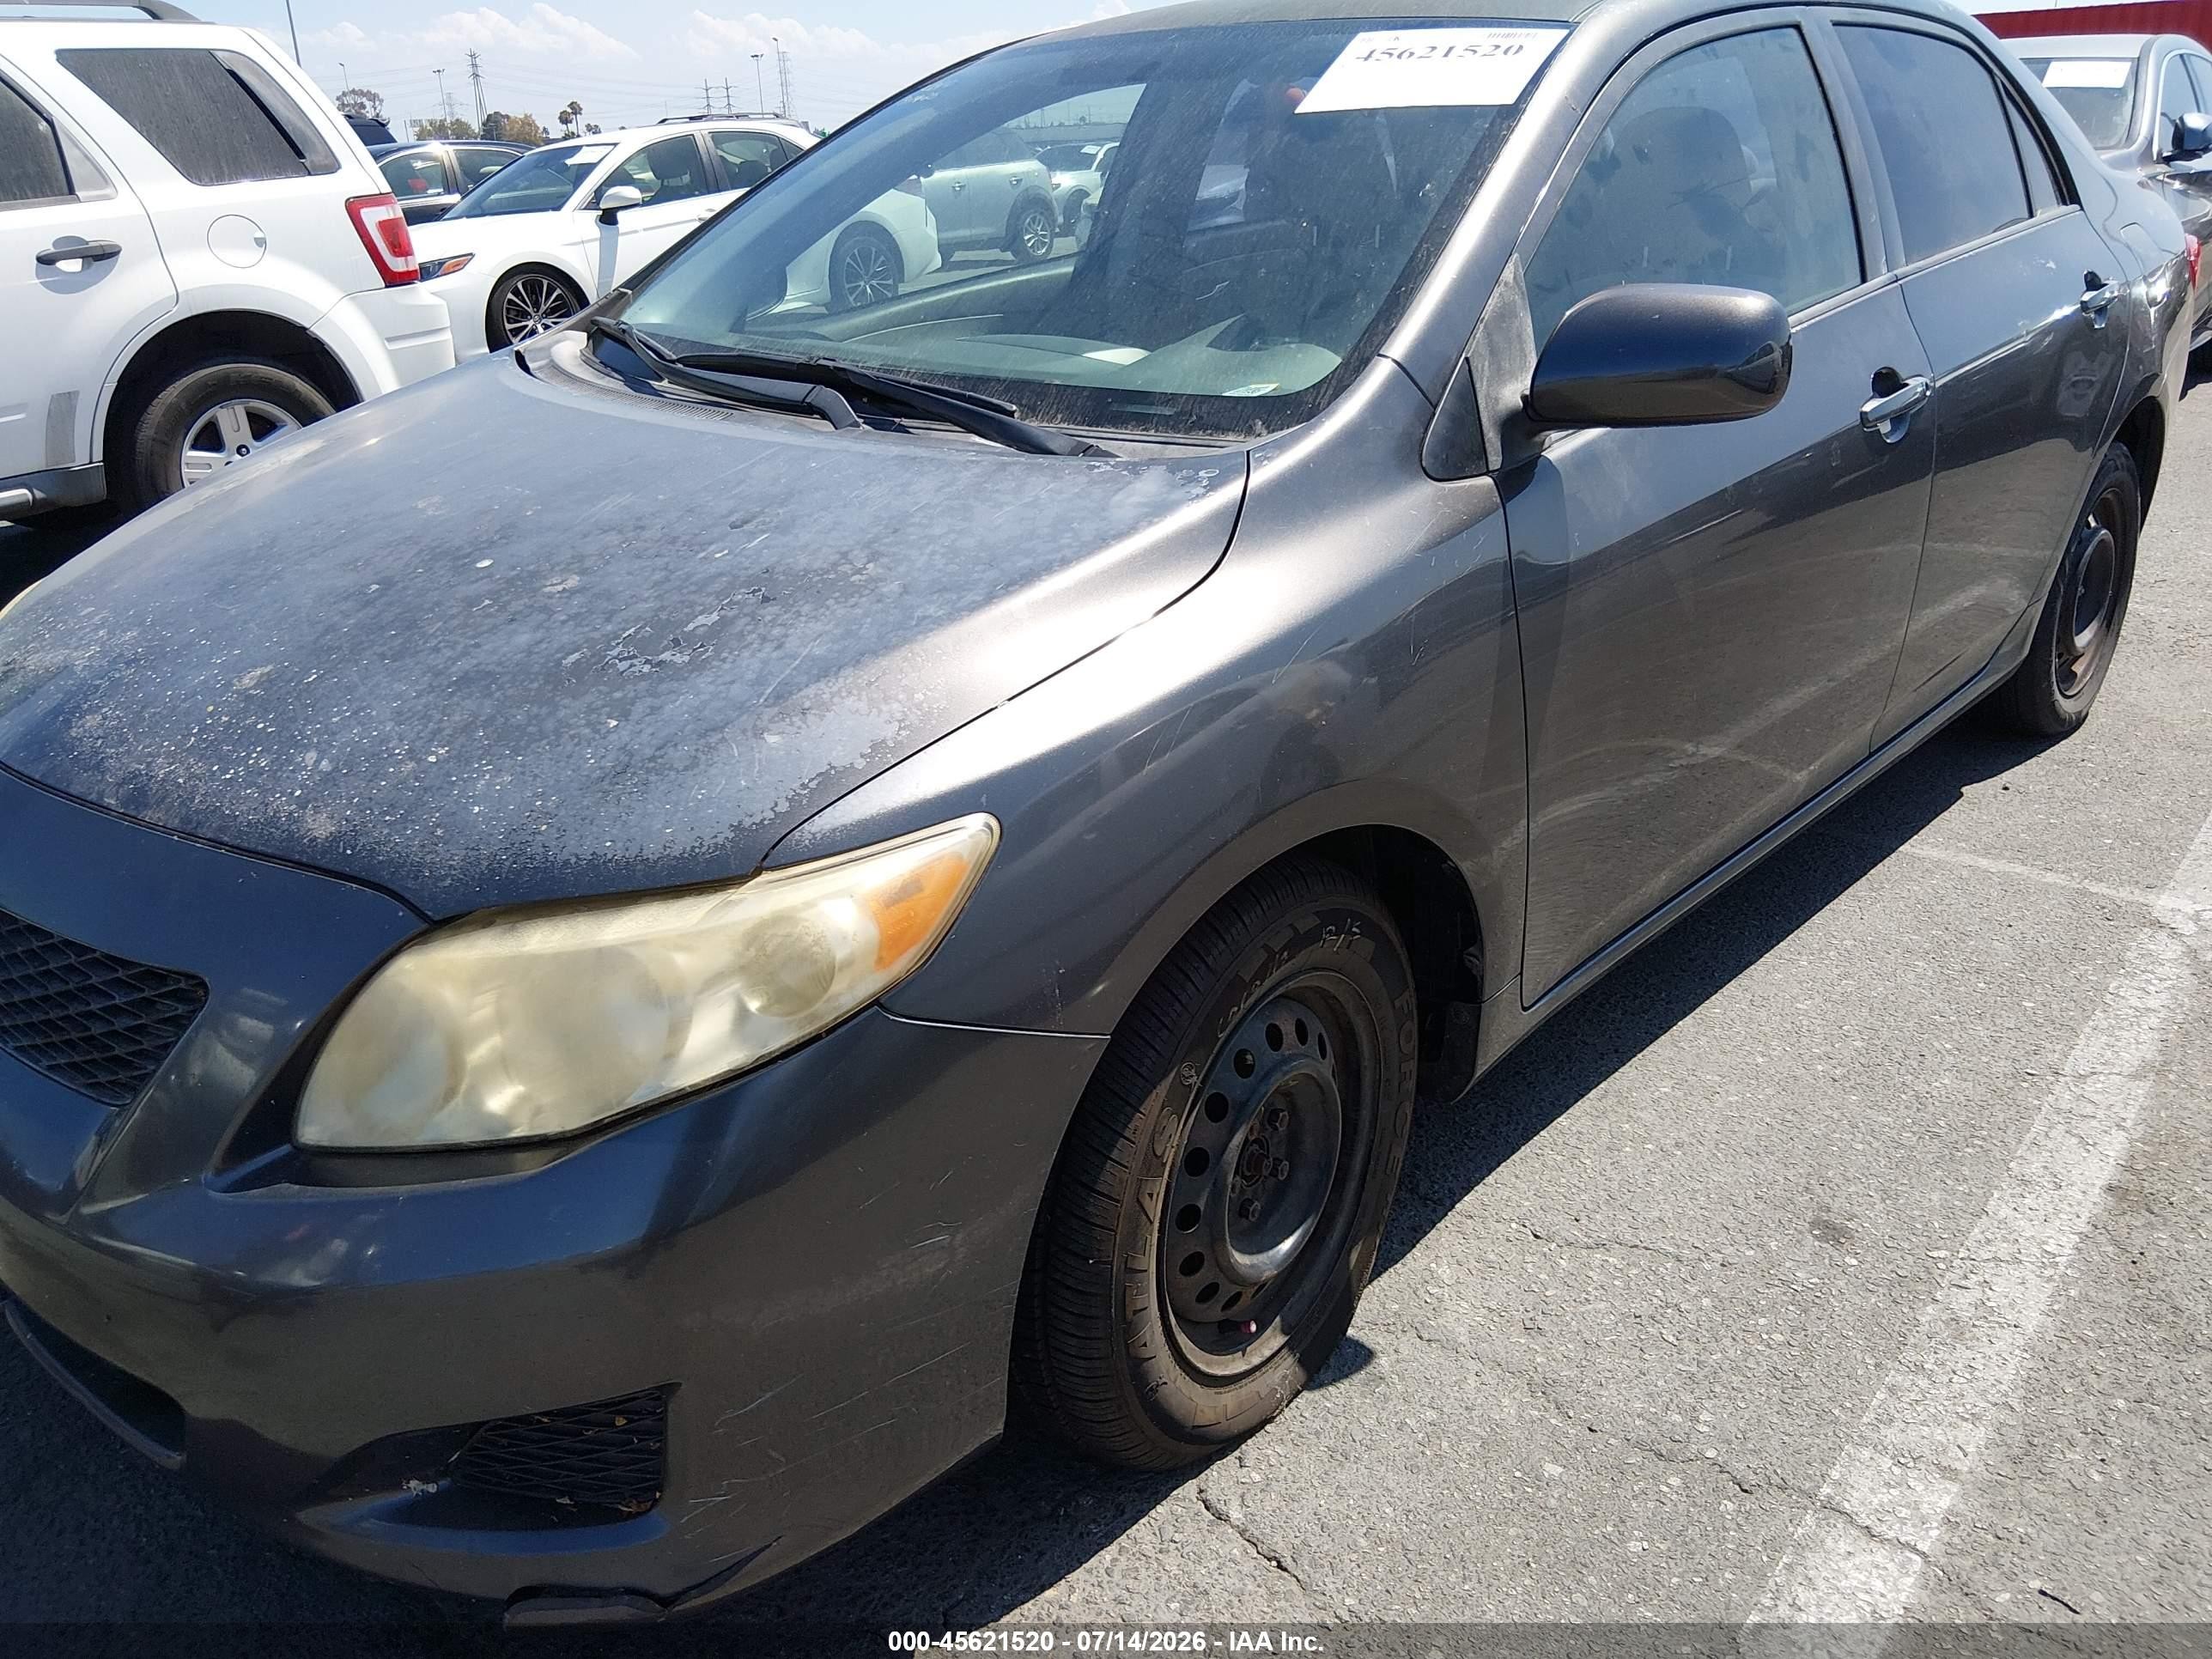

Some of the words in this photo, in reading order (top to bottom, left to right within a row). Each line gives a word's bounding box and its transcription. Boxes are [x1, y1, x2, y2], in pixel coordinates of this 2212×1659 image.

[1355, 43, 1525, 63] 45621520
[1383, 988, 1418, 1176] FORCE
[1123, 1104, 1179, 1360] ATLAS
